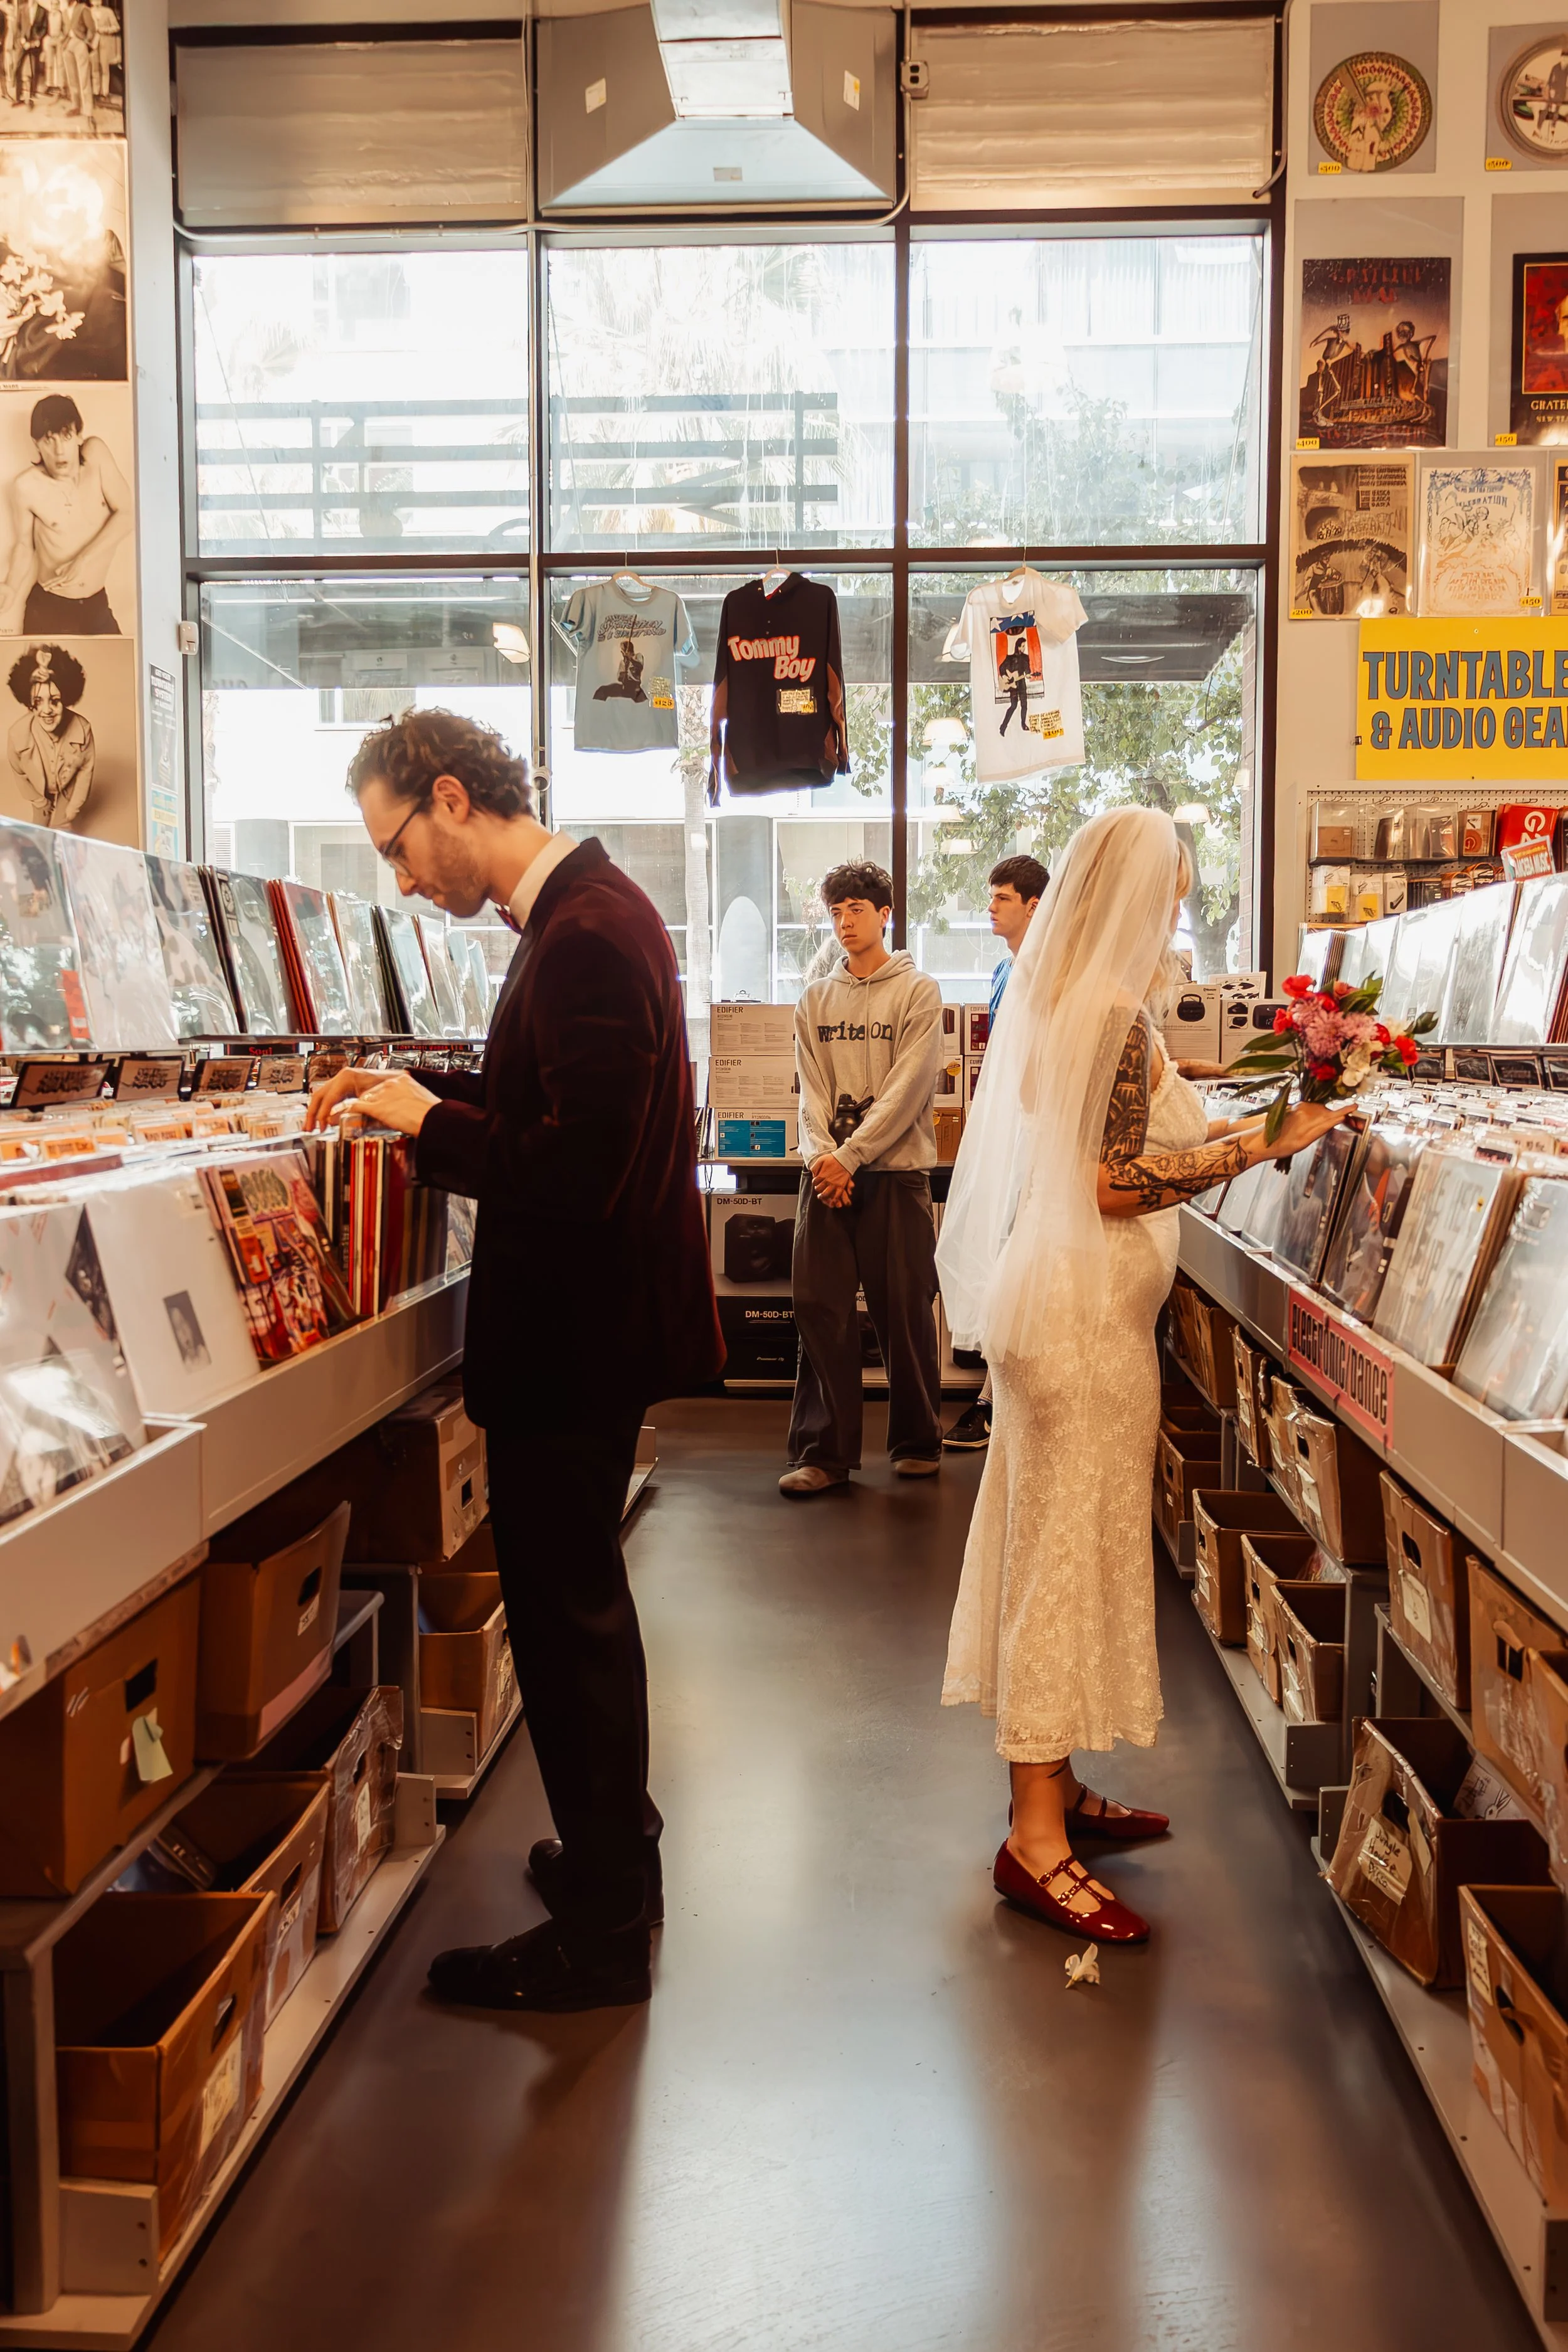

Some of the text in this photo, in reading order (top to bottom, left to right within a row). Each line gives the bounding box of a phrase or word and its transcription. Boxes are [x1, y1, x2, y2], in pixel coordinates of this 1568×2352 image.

[1530, 400, 1568, 410] GRATE
[728, 635, 800, 661] Tommy
[773, 655, 816, 682] Boy
[1370, 706, 1568, 750] & AUDIO GEA
